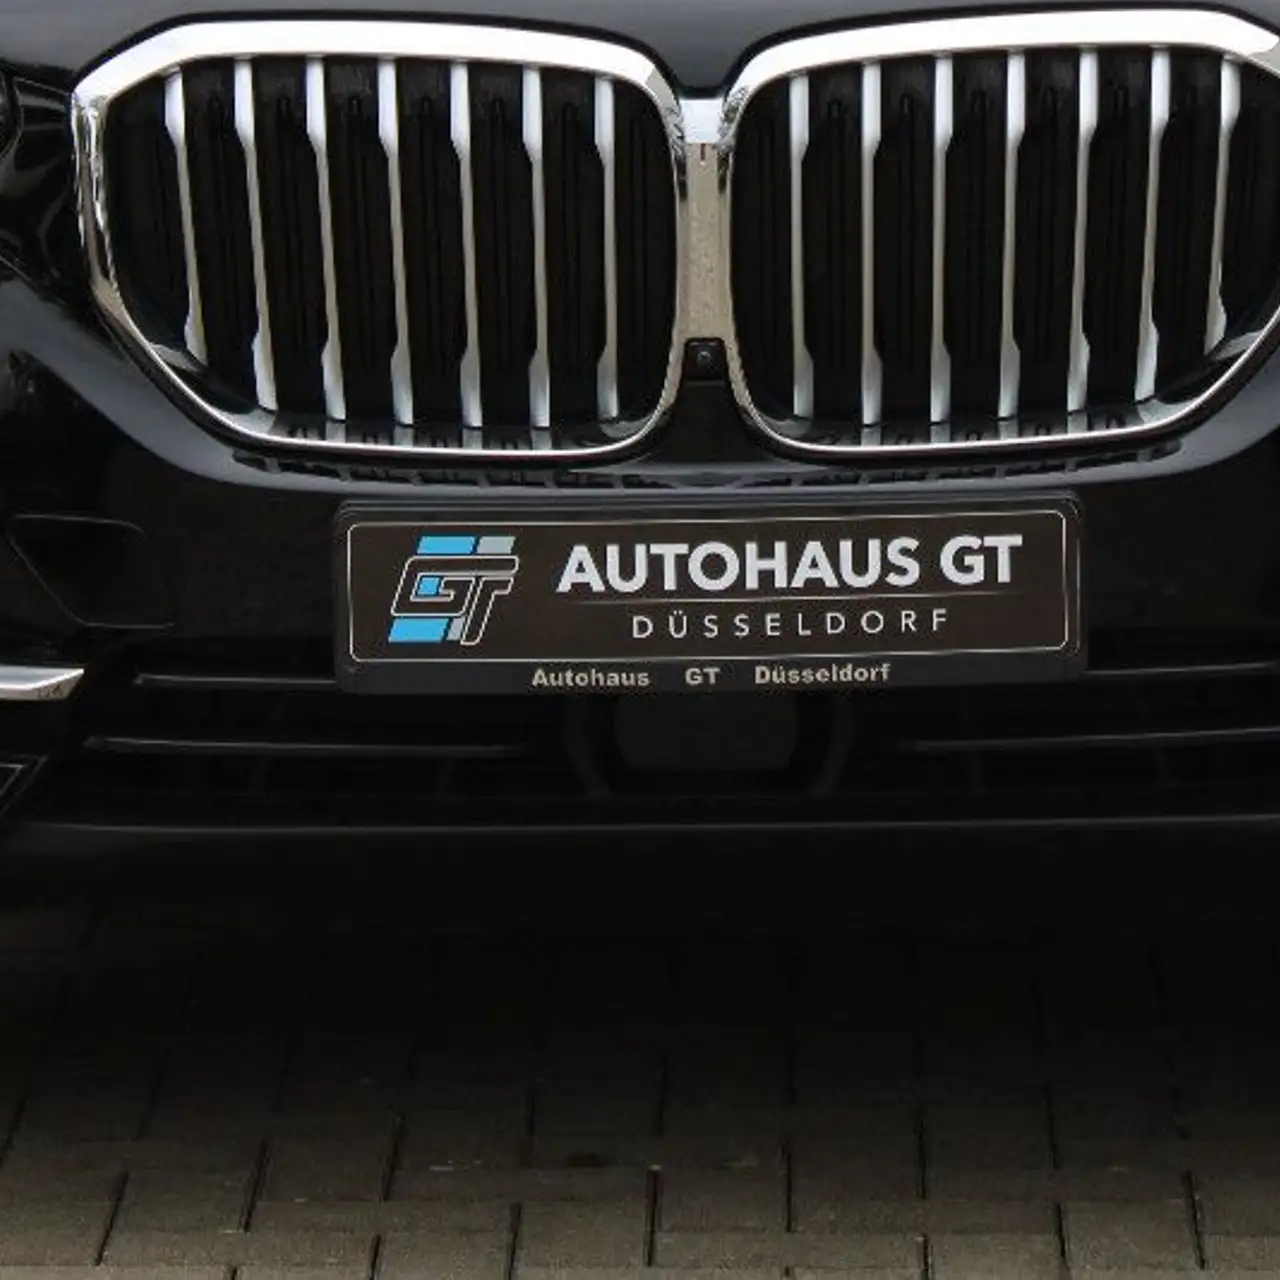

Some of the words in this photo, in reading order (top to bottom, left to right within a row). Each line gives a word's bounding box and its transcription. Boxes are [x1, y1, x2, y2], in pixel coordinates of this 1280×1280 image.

[556, 538, 922, 593] AUTOHAUS
[939, 534, 1023, 585] GT
[632, 608, 948, 639] DÜSSELDORF
[531, 667, 650, 688] Autohaus
[684, 666, 720, 686] GT
[753, 662, 891, 685] Düsseldorf
